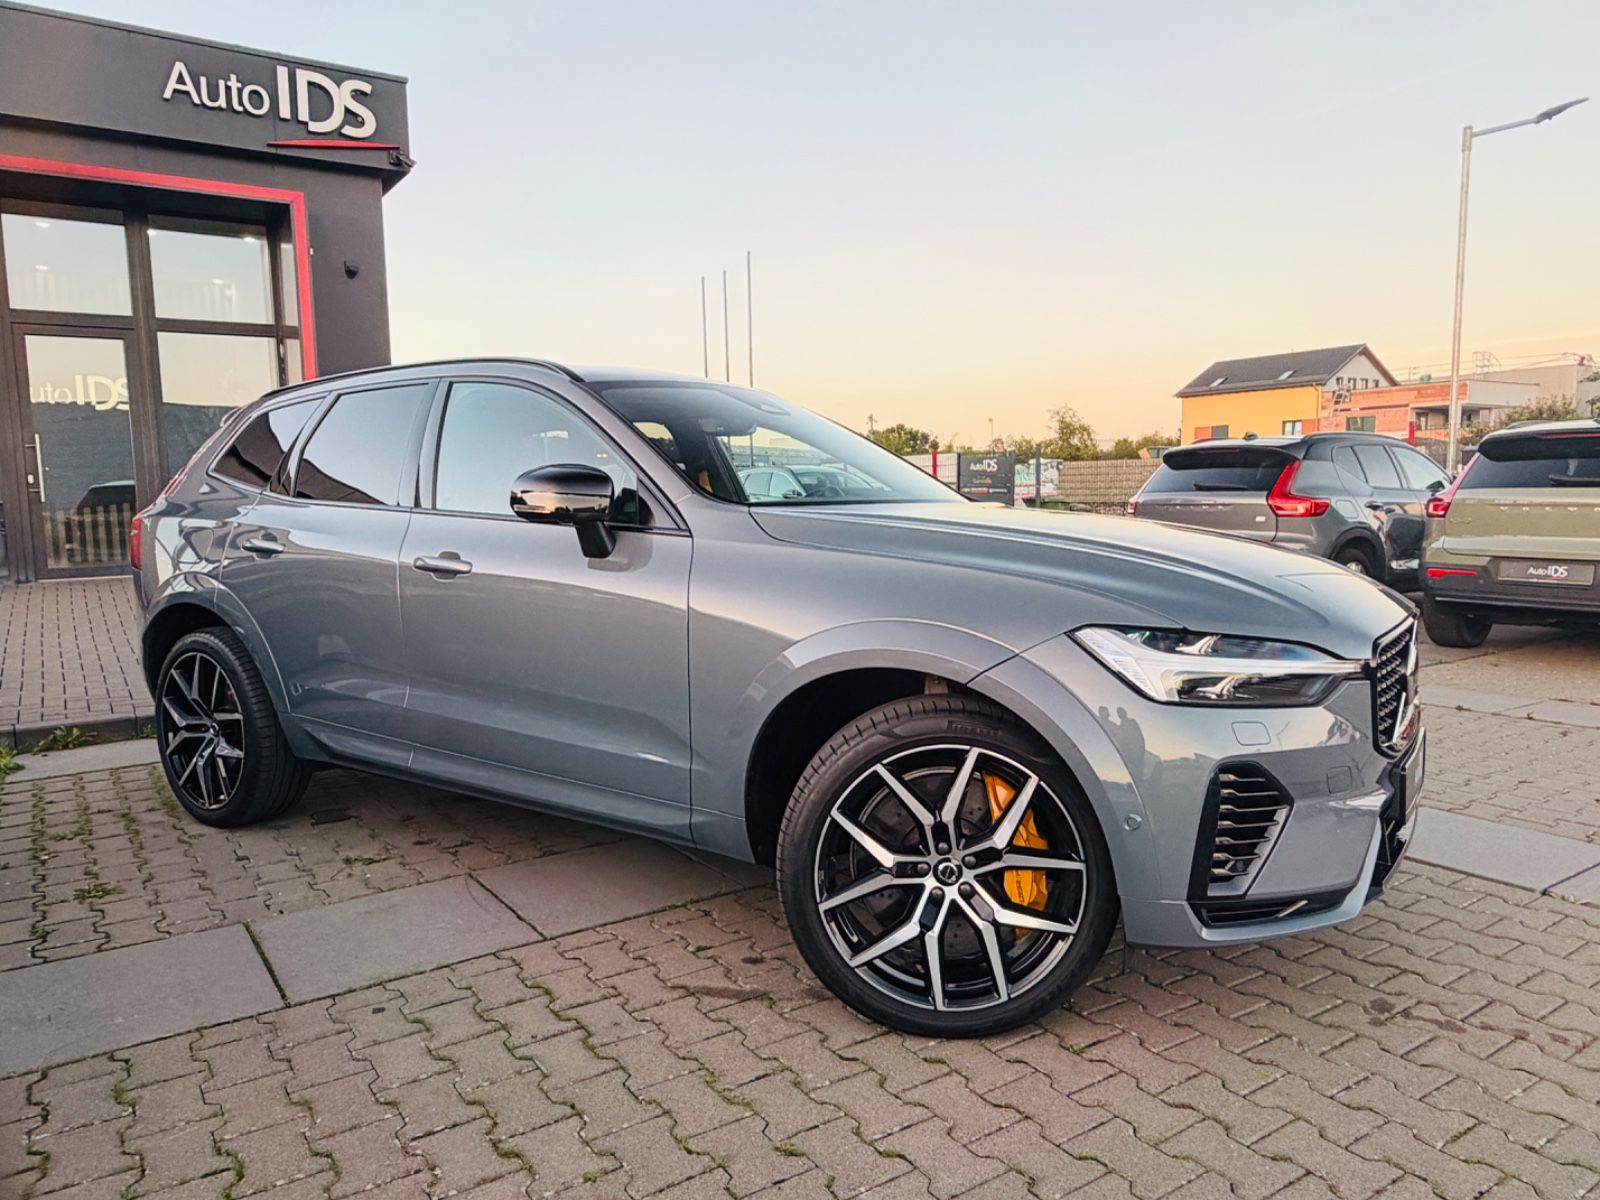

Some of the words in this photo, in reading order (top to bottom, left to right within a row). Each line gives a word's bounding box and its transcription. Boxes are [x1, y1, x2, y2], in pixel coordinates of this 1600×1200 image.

[163, 61, 270, 116] Auto
[276, 65, 376, 138] IDS
[30, 382, 72, 404] uto
[1527, 566, 1547, 576] Auto
[1547, 565, 1568, 577] IDS
